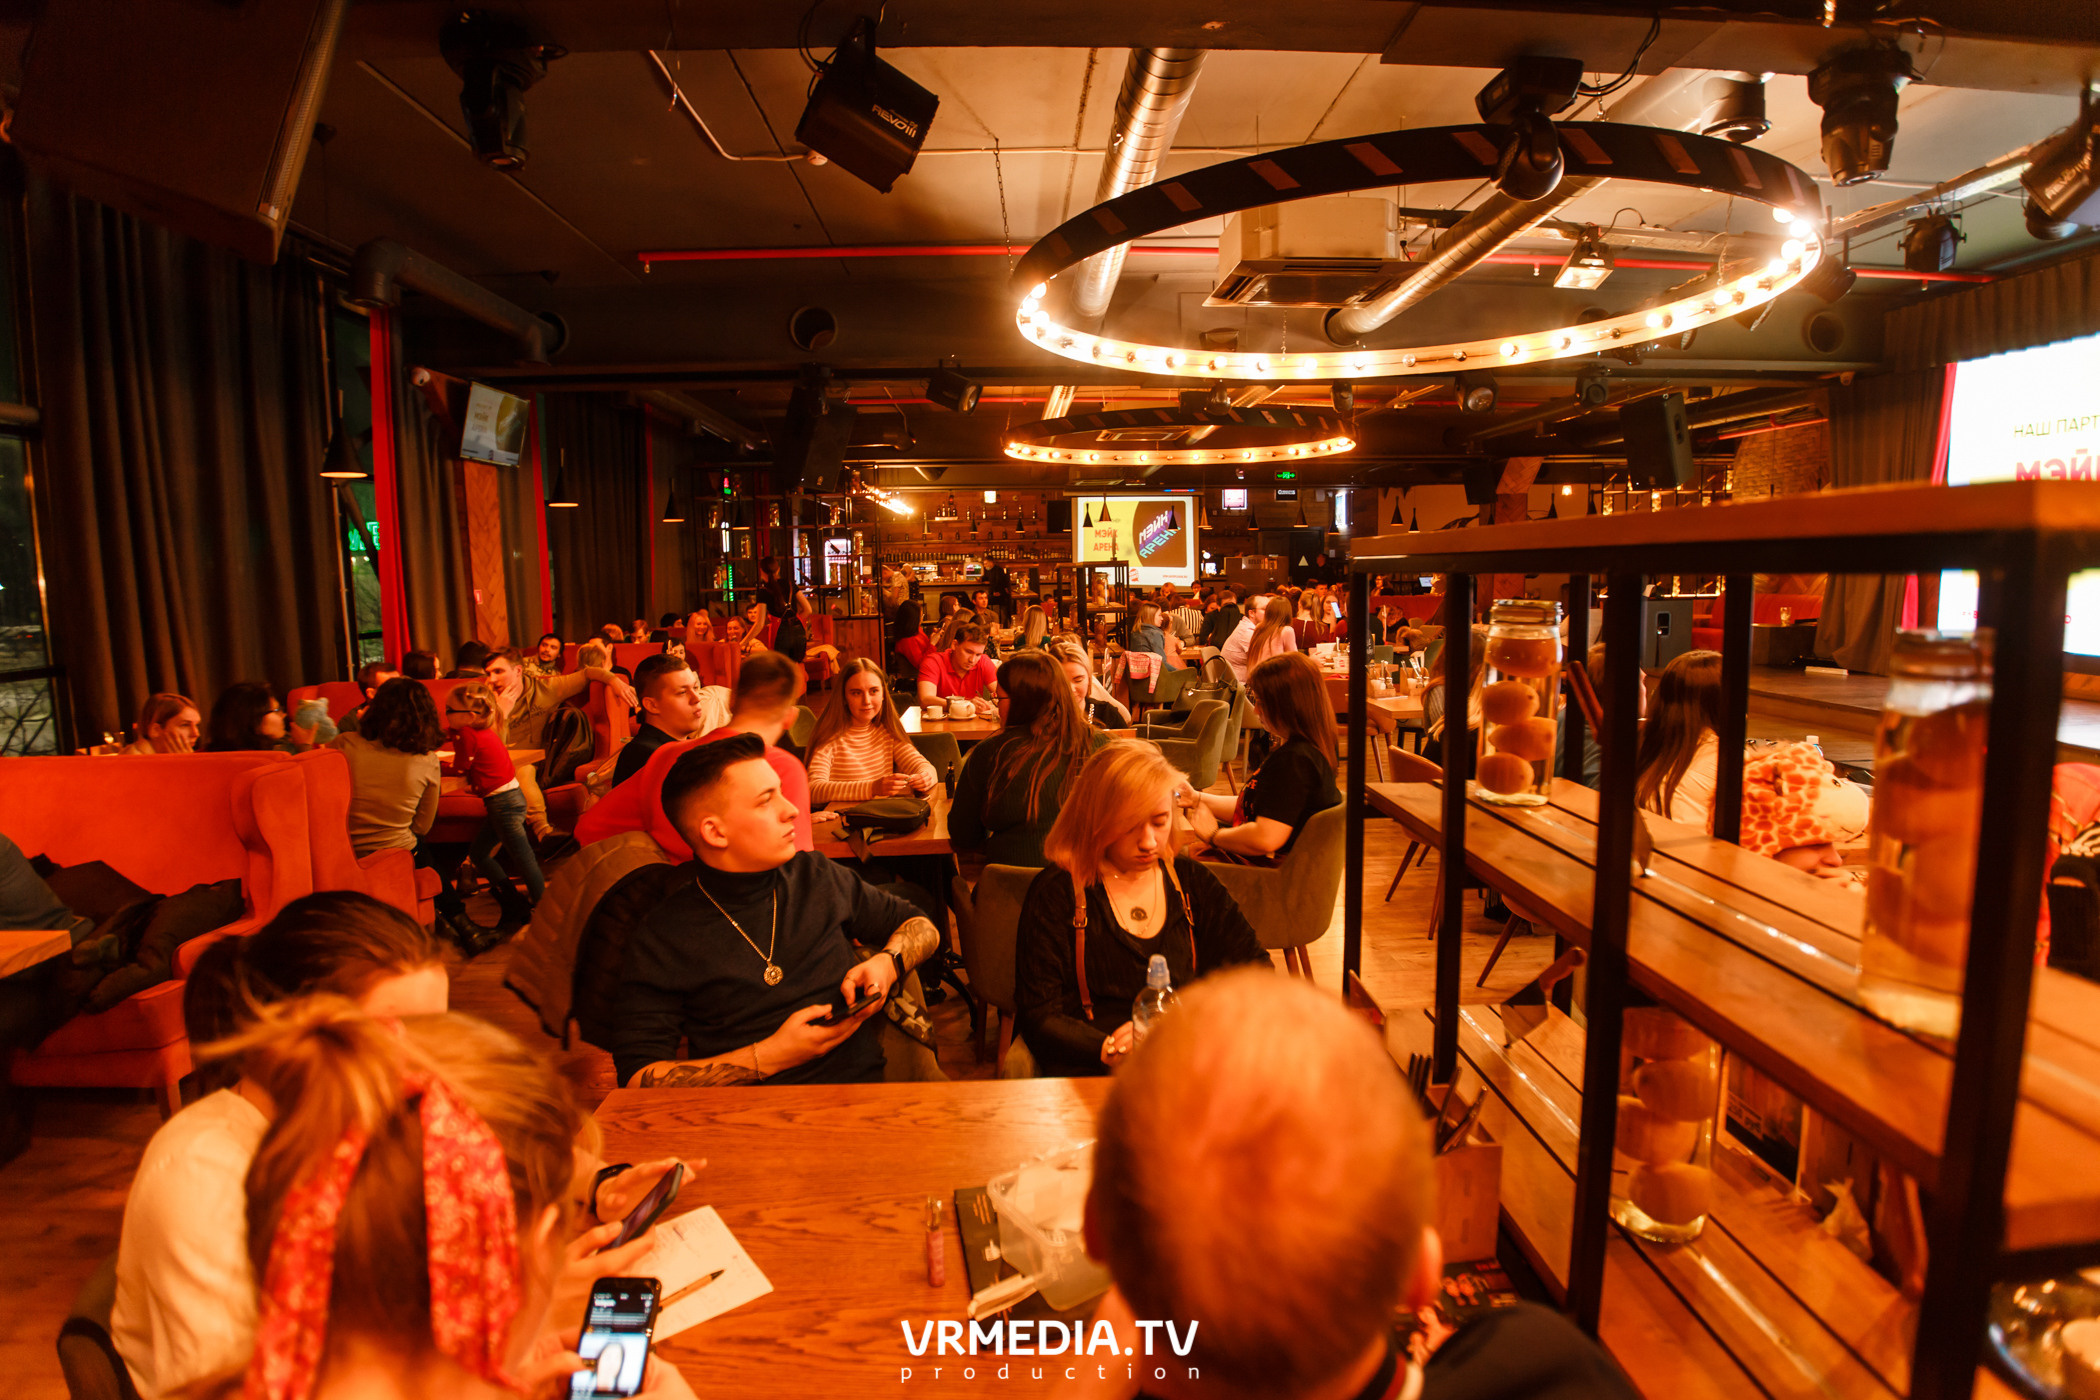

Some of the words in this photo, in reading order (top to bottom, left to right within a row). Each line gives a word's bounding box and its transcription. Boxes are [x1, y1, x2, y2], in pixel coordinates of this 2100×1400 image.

[2013, 421, 2050, 438] НАШ
[2057, 415, 2100, 434] ПАРТ
[2016, 449, 2100, 481] МЭЙ
